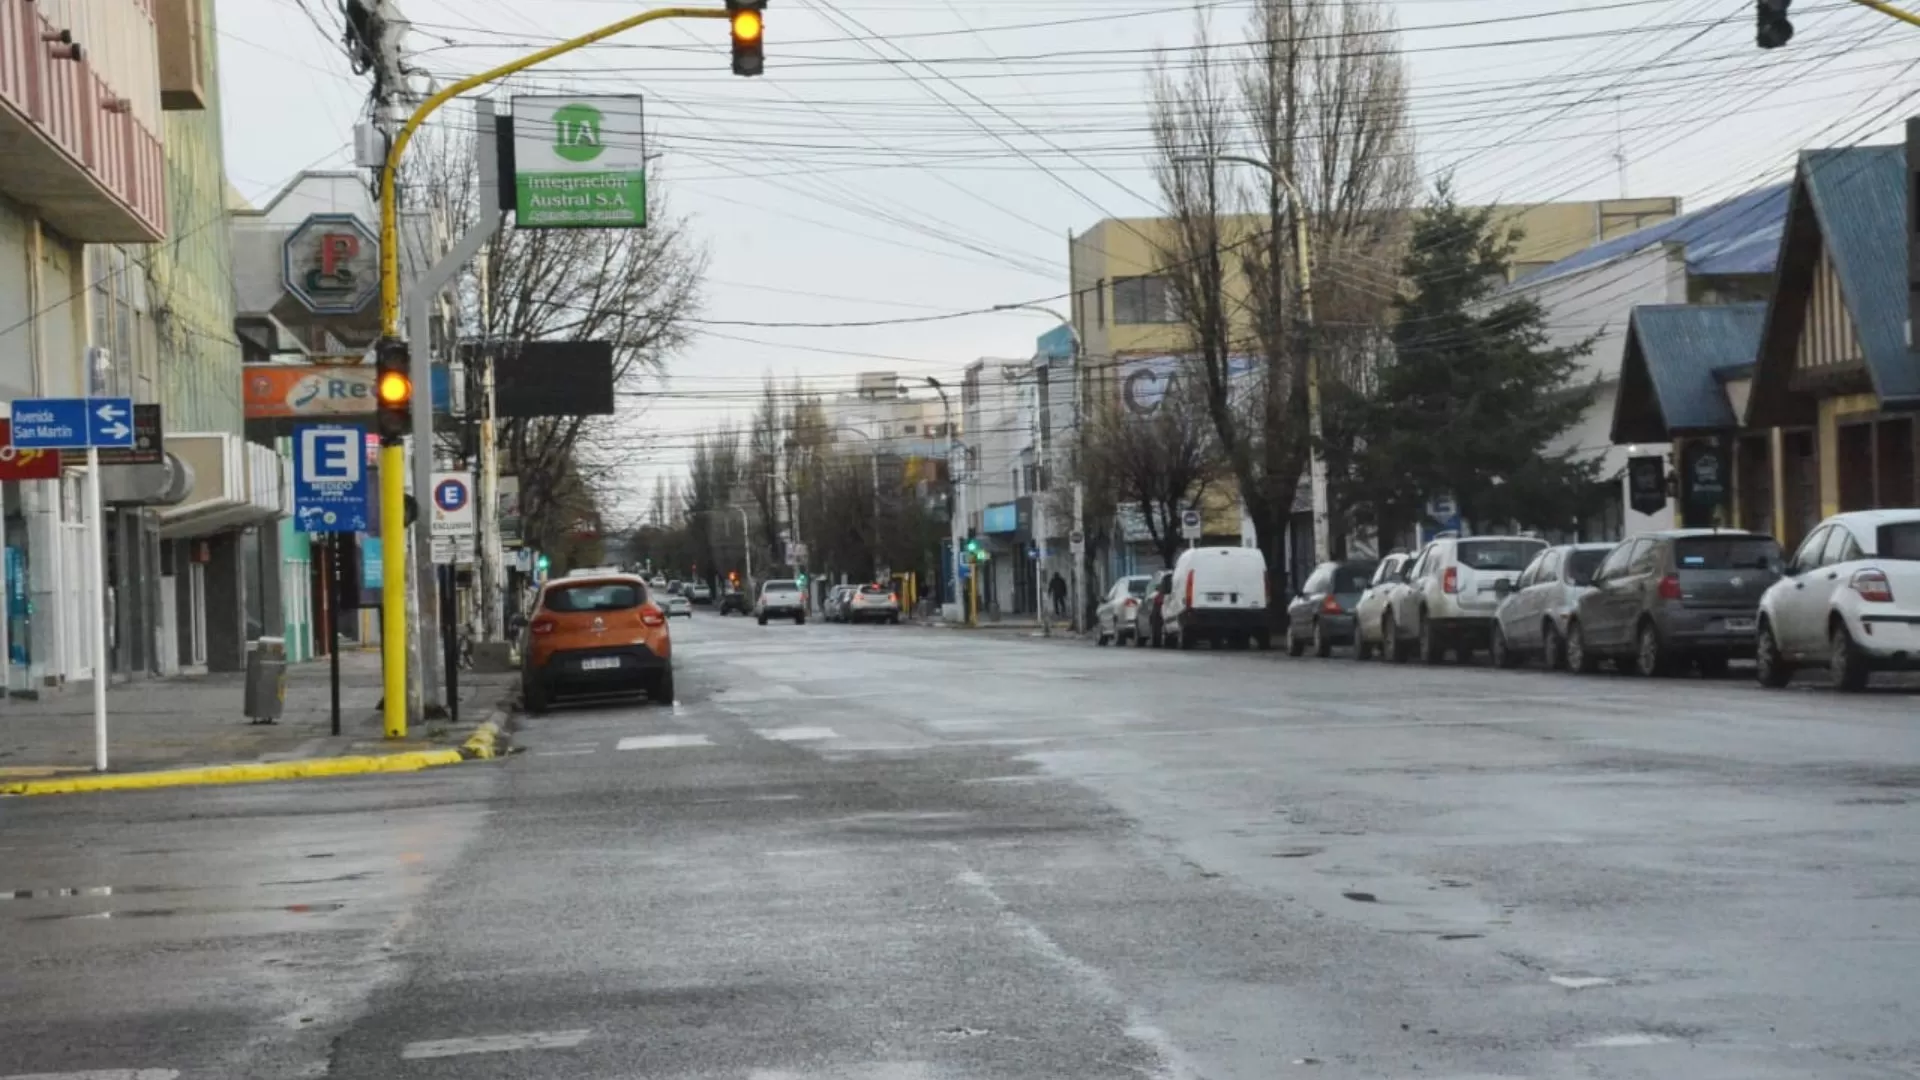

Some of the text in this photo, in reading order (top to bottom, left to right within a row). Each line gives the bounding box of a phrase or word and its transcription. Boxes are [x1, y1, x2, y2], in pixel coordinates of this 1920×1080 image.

[528, 174, 628, 191] Integración
[530, 193, 590, 207] Austral
[321, 233, 360, 275] P
[328, 379, 377, 399] Re
[15, 410, 55, 423] Avenida
[15, 426, 36, 439] San
[314, 435, 346, 476] E
[444, 486, 459, 504] E
